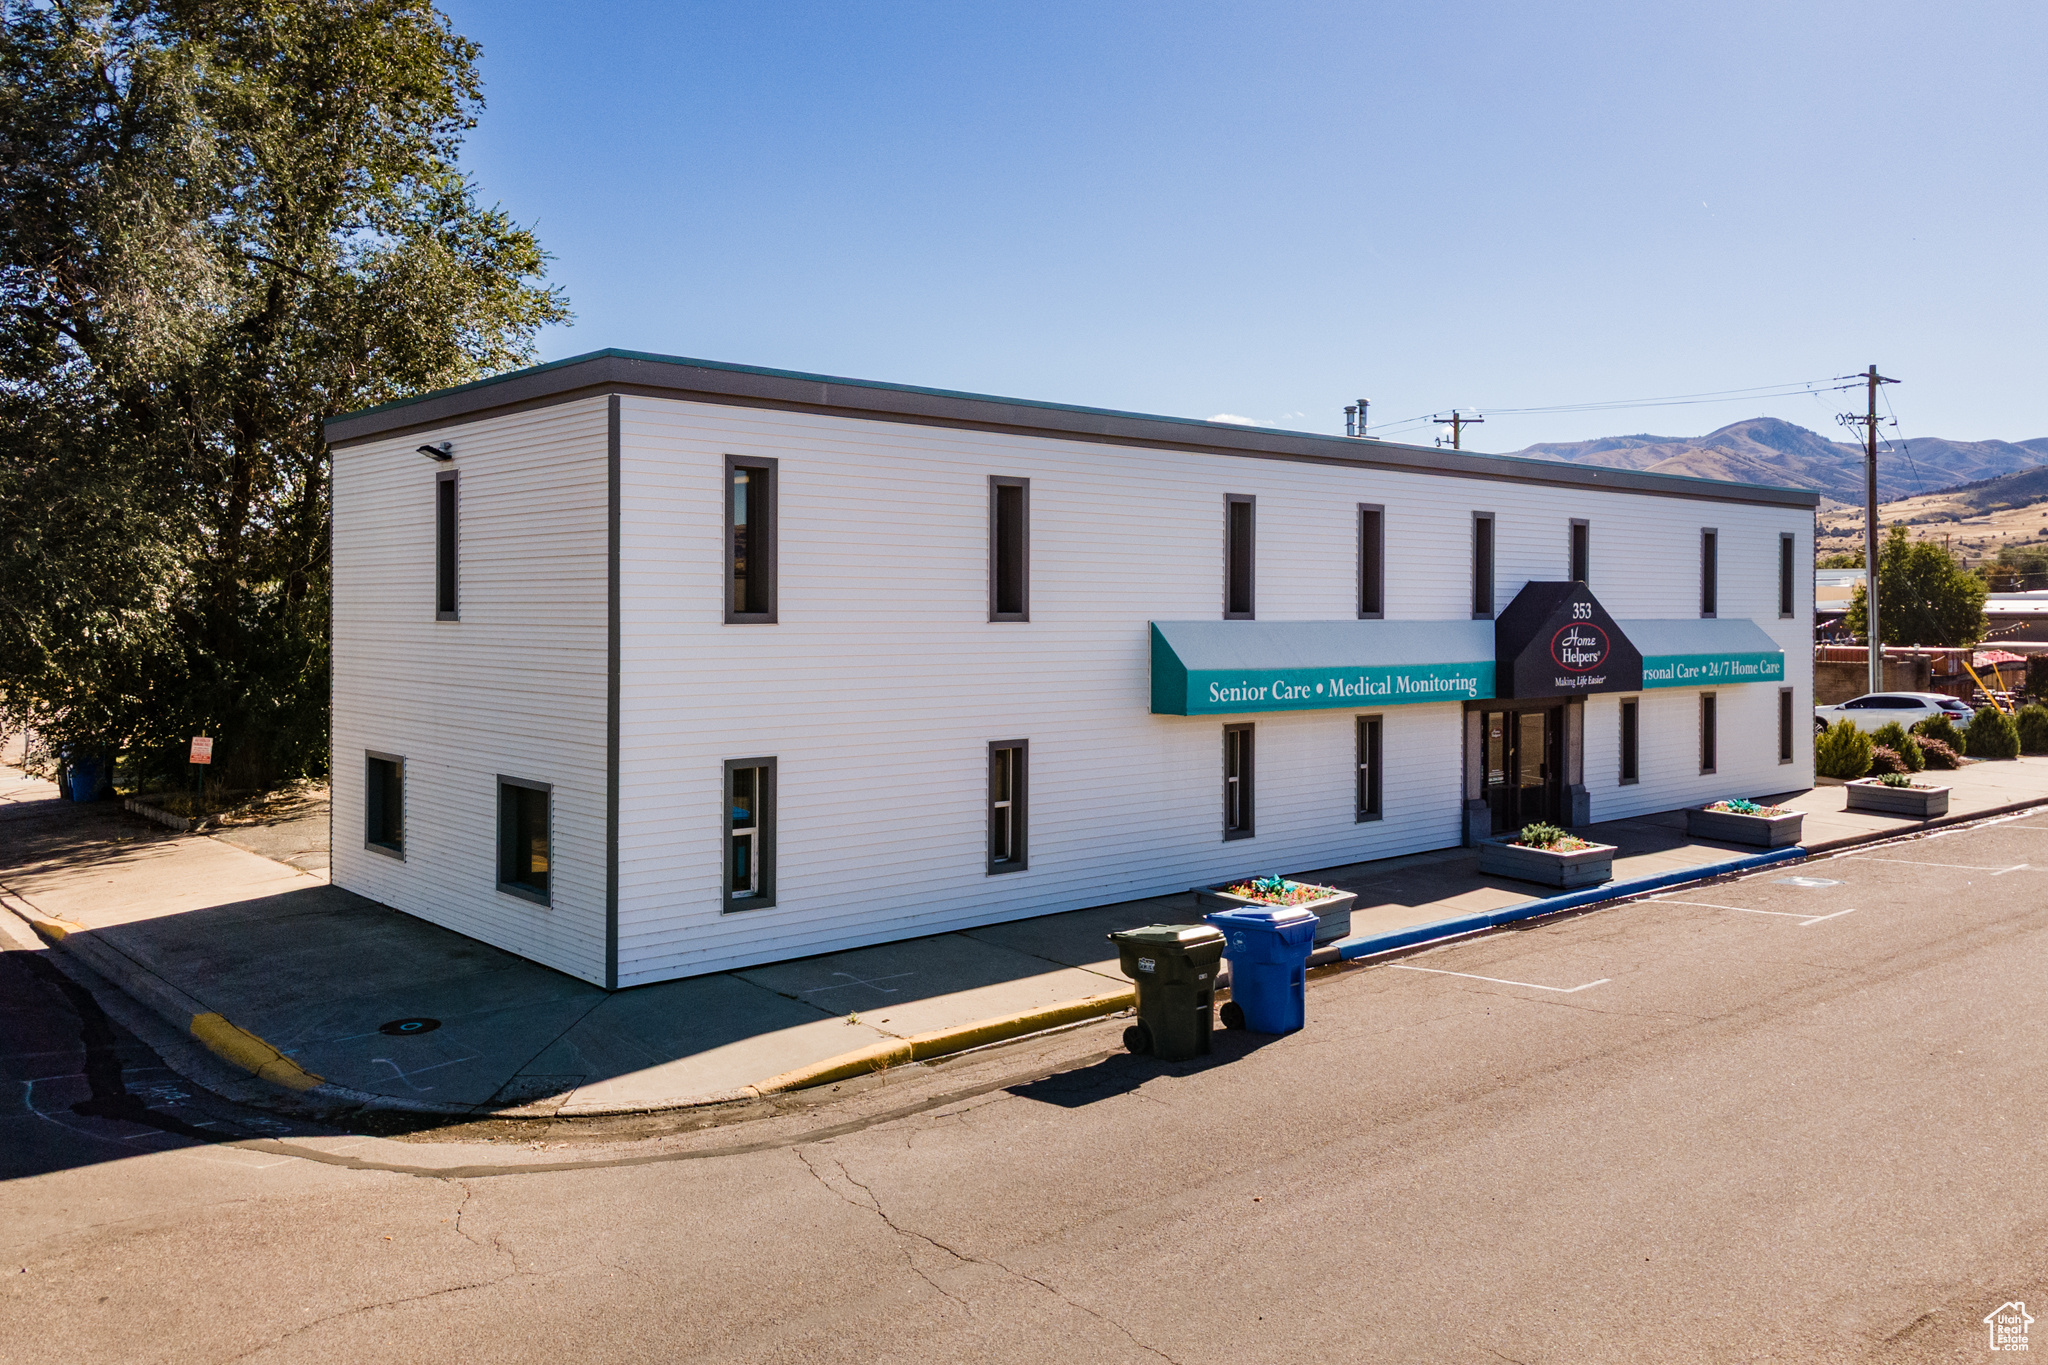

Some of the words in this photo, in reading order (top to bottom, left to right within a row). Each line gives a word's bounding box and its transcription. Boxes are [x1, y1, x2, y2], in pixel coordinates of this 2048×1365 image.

[1572, 602, 1592, 619] 353
[1561, 626, 1596, 647] Home
[1562, 647, 1598, 667] Helpers
[1643, 663, 1674, 680] rsonal
[1676, 663, 1699, 678] Care
[1708, 661, 1730, 677] 24/7
[1731, 661, 1758, 675] Home
[1760, 659, 1780, 674] Care
[1209, 680, 1267, 703] Senior
[1272, 680, 1311, 701] Care
[1328, 675, 1391, 698] Medical
[1395, 672, 1478, 697] Monitoring
[1555, 676, 1576, 688] Making
[1576, 675, 1588, 688] Life
[1588, 675, 1605, 685] Easier
